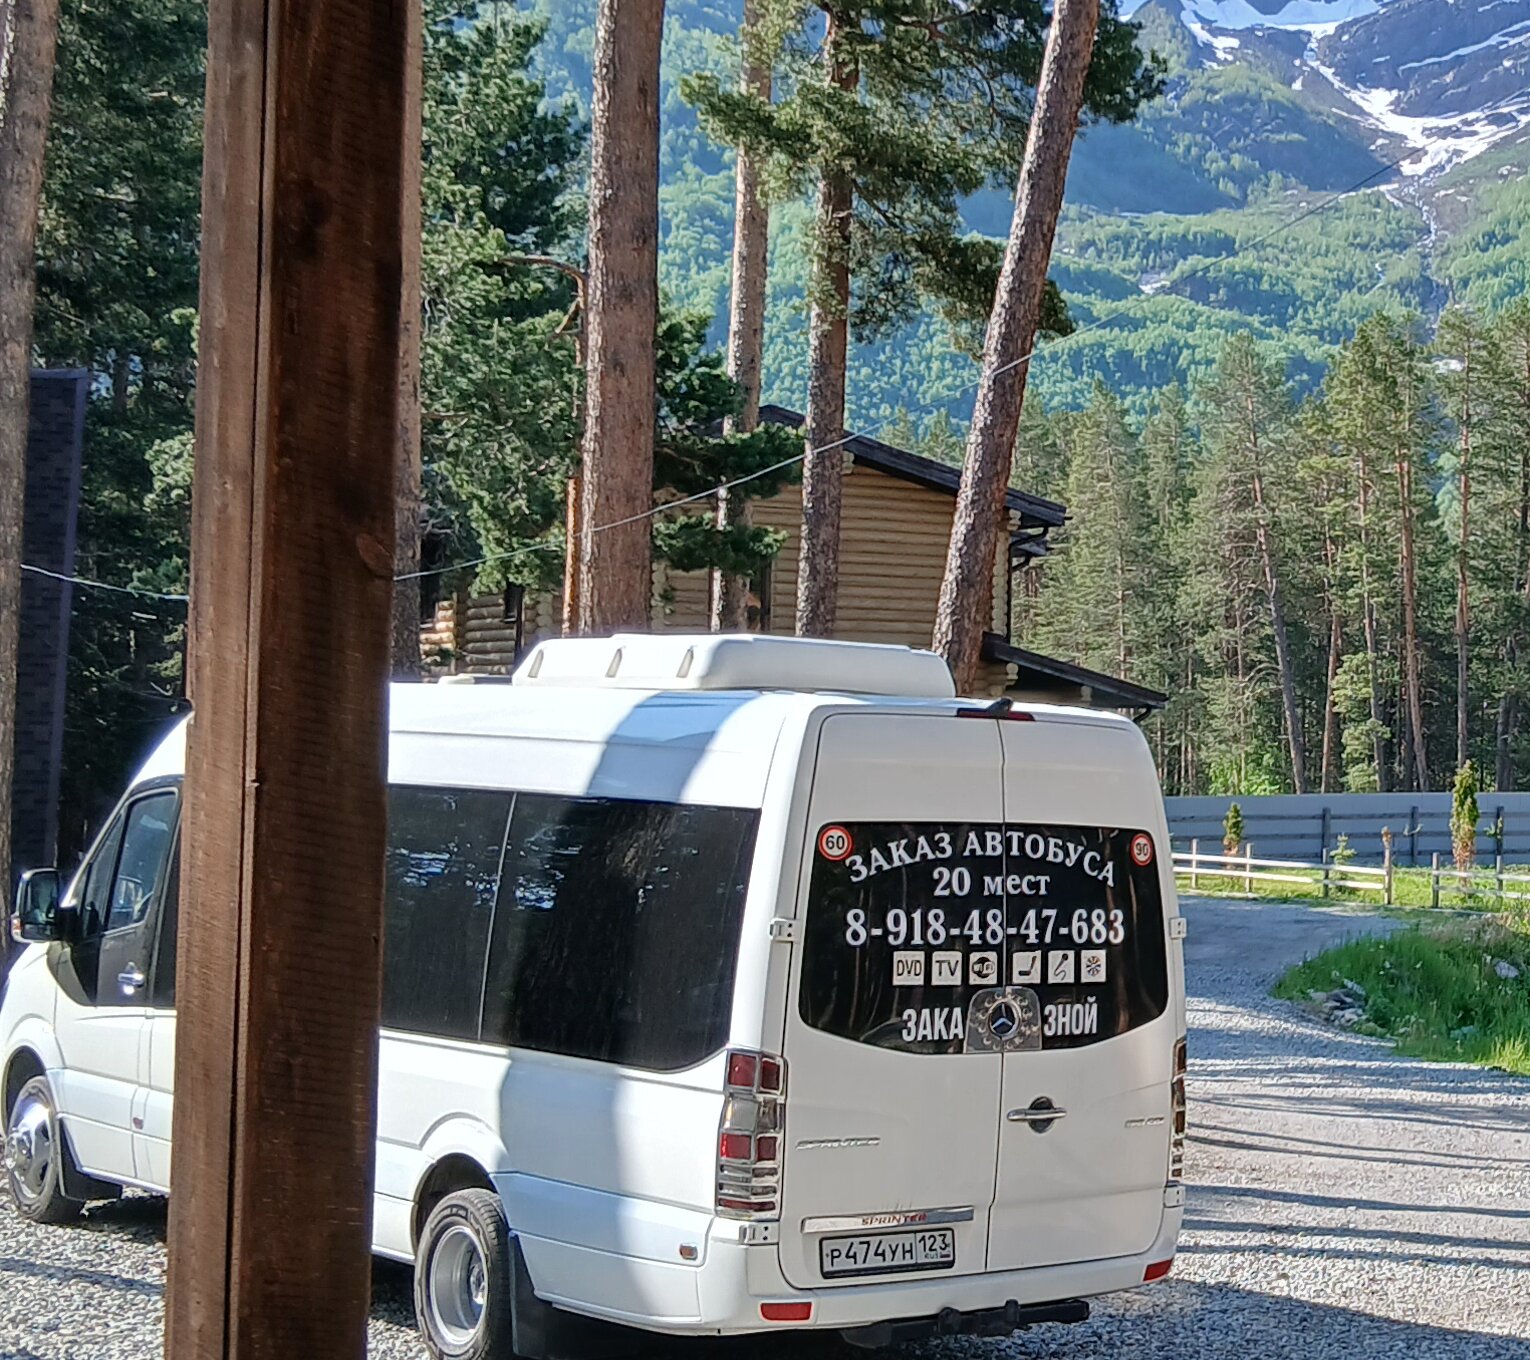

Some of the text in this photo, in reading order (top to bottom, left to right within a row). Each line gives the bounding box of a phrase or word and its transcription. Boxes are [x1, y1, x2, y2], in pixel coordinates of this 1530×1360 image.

[826, 835, 845, 850] 60
[1135, 842, 1149, 856] 90
[845, 830, 1116, 888] ЗАКАЗ АВТОБУСА
[932, 866, 1051, 897] 20 мест
[845, 907, 1126, 946] 8-918-48-47-683
[896, 959, 923, 977] DVD
[935, 959, 960, 977] TV
[901, 995, 1099, 1042] ЗАКА ЗНОЙ
[861, 1211, 928, 1226] SPRINTER
